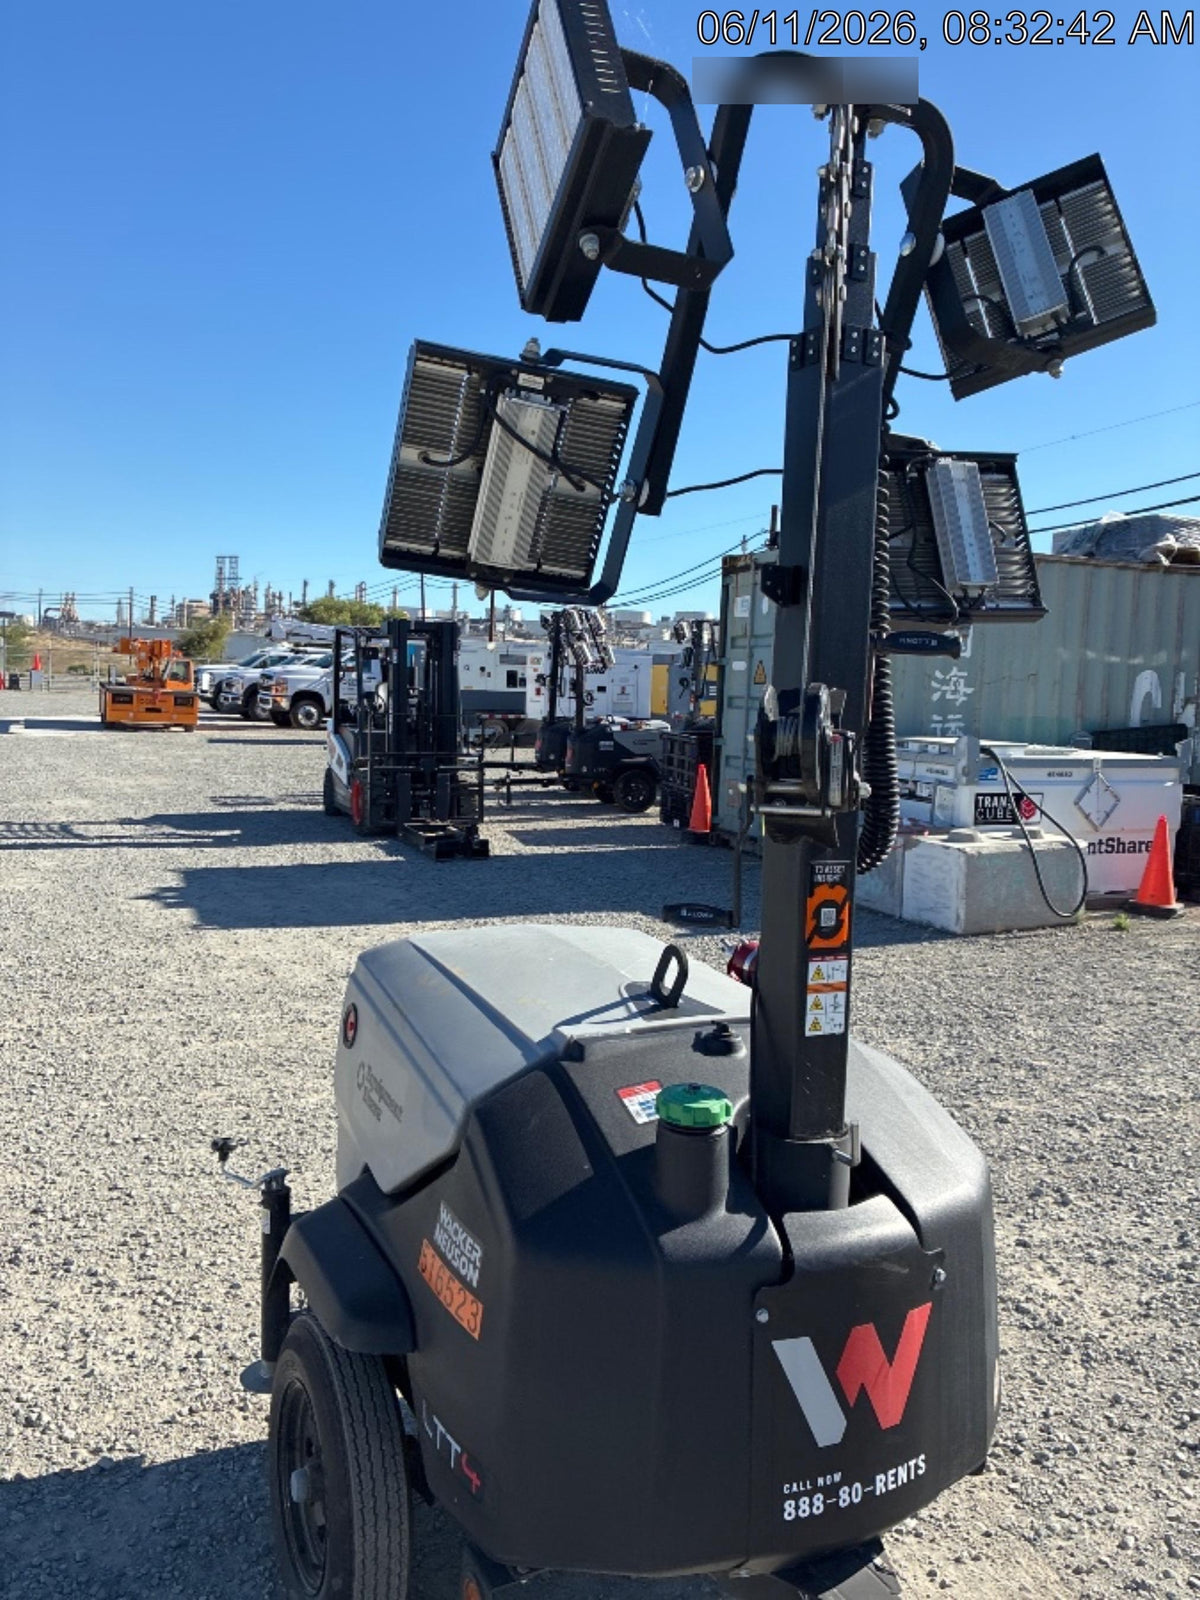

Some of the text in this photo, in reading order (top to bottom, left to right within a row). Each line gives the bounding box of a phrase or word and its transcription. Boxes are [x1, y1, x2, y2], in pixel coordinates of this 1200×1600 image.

[1087, 837, 1153, 855] ntShare
[433, 1222, 479, 1289] NEUSON
[440, 1201, 482, 1269] WACKER
[783, 1471, 842, 1494] CALL NOW
[783, 1453, 927, 1521] 888-80-RENTS
